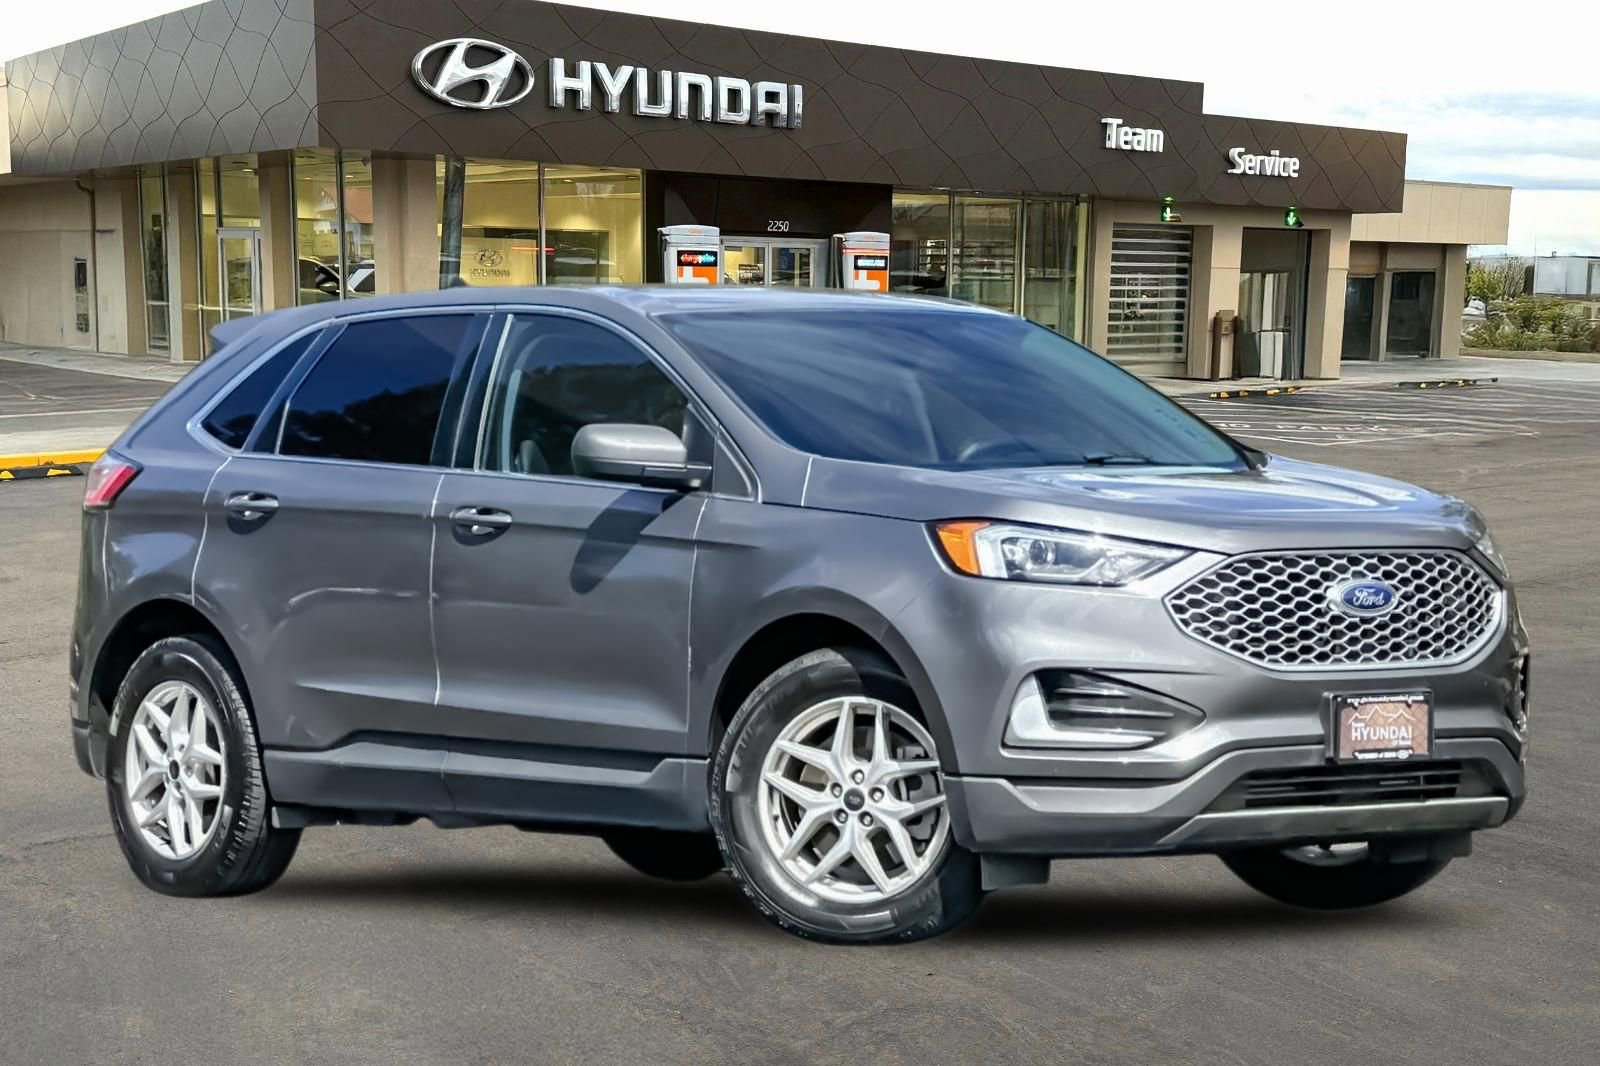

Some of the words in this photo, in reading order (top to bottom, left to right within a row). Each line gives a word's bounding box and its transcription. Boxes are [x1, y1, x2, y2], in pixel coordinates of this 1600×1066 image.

[549, 57, 803, 128] HYUNDAI
[1101, 118, 1164, 152] Team
[1228, 147, 1301, 177] Service
[767, 219, 789, 233] 2250
[1353, 587, 1385, 606] Ford
[1352, 725, 1412, 741] HYUNDAI
